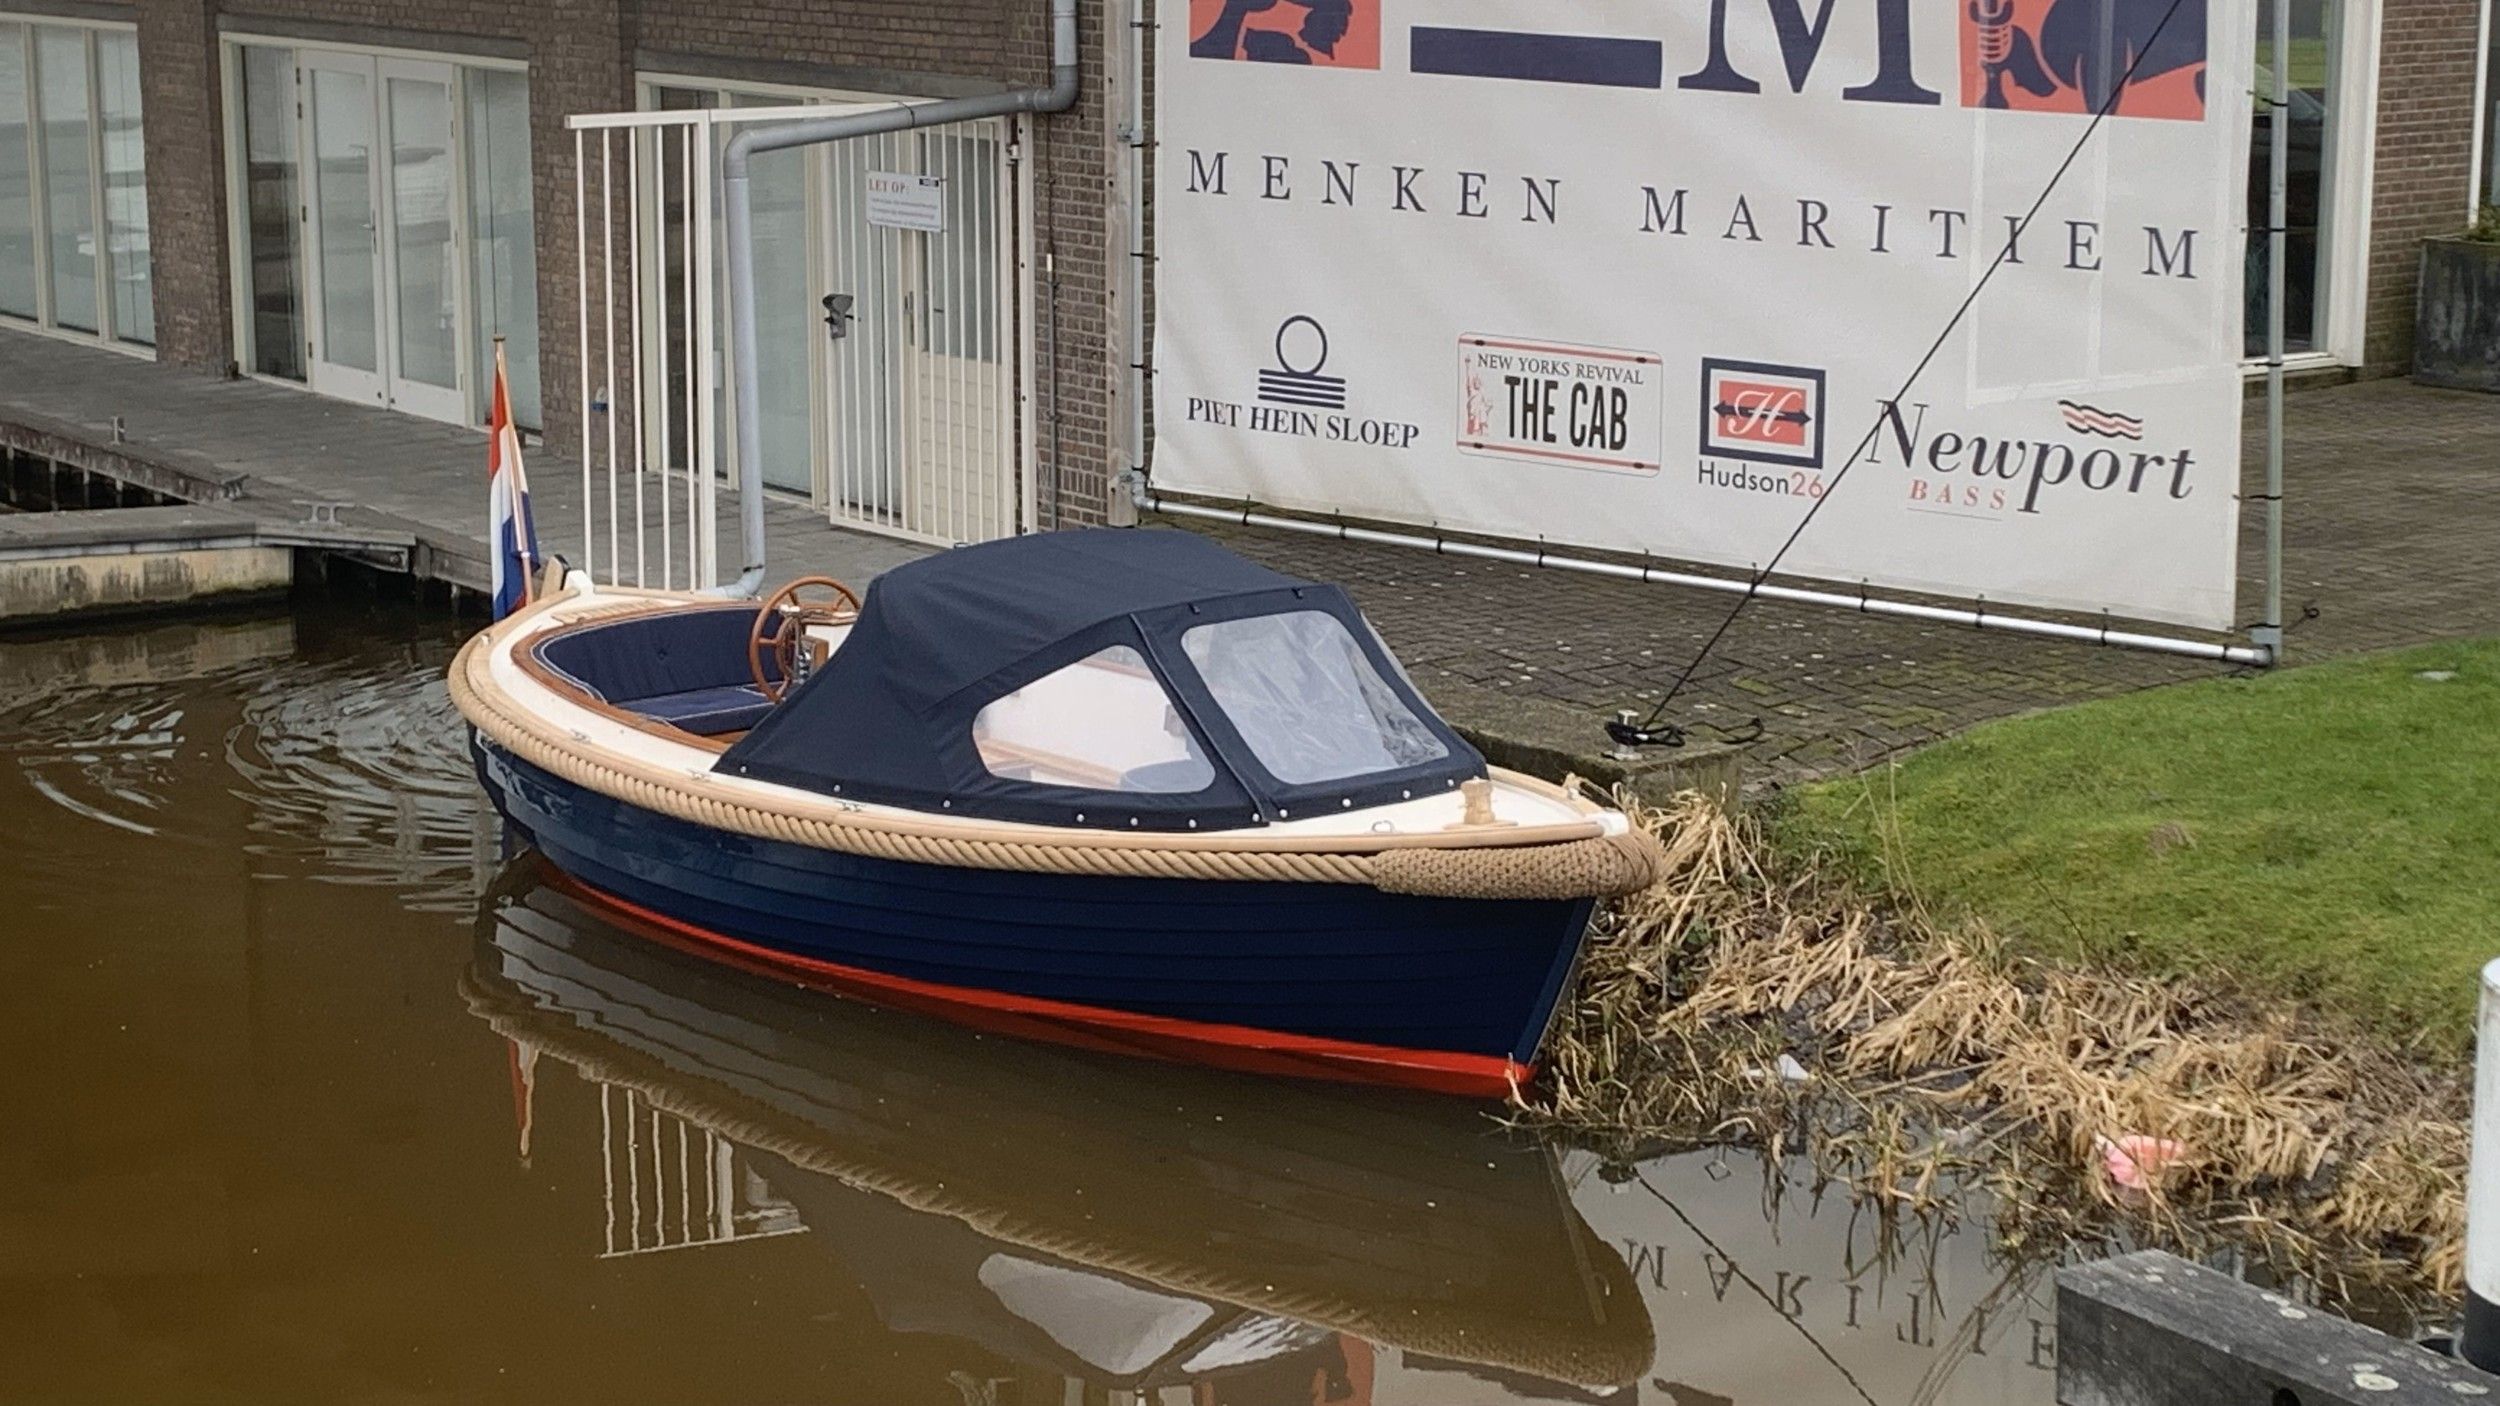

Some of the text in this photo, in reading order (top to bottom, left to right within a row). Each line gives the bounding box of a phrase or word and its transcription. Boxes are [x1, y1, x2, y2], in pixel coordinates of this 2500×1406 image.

[1186, 149, 2199, 280] MENKEN MARITIEM
[1477, 352, 1644, 386] NEW YORKS REVIVAL
[1187, 397, 1420, 449] PIET HEIN SLOEP
[1503, 374, 1629, 452] THE CAB
[1698, 458, 1823, 499] Hudson26
[1864, 399, 2198, 515] Newport
[1908, 478, 2006, 510] BASS
